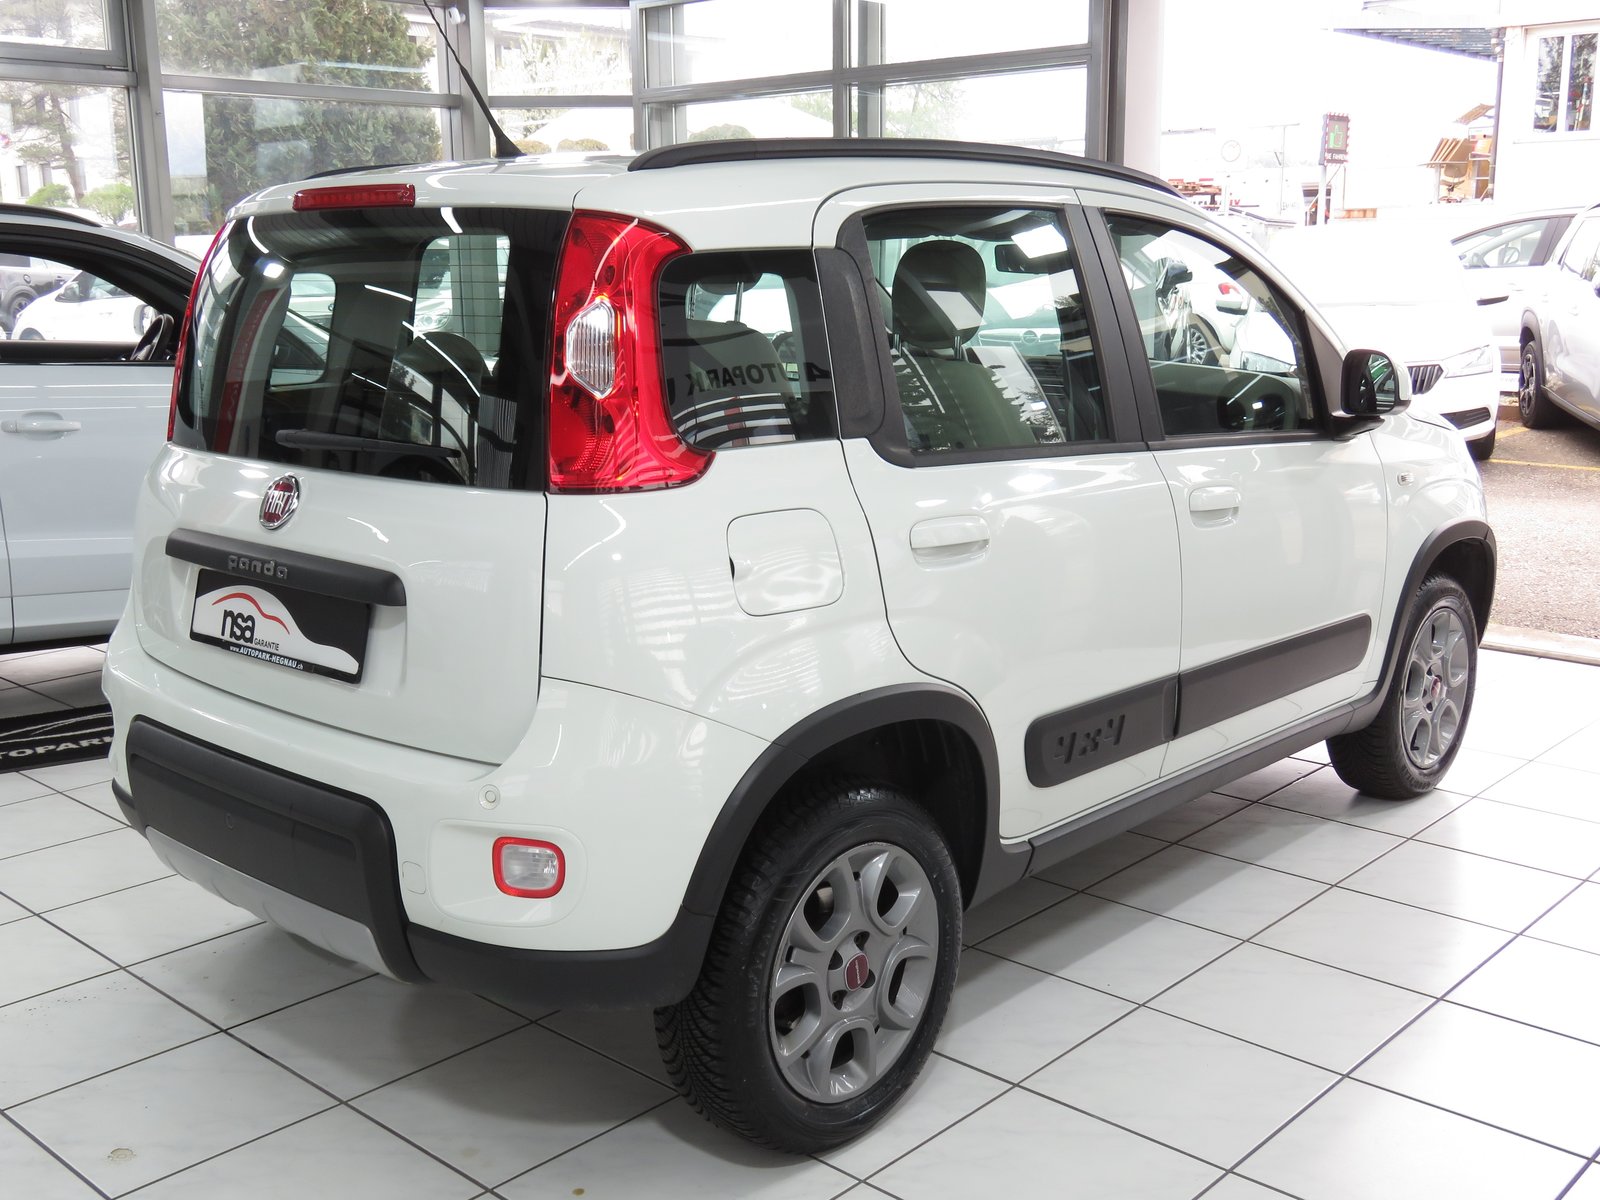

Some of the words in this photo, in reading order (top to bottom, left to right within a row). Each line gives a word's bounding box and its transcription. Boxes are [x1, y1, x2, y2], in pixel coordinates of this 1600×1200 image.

[228, 555, 288, 580] panda
[221, 609, 256, 644] nsa
[254, 638, 280, 651] GARANTIE
